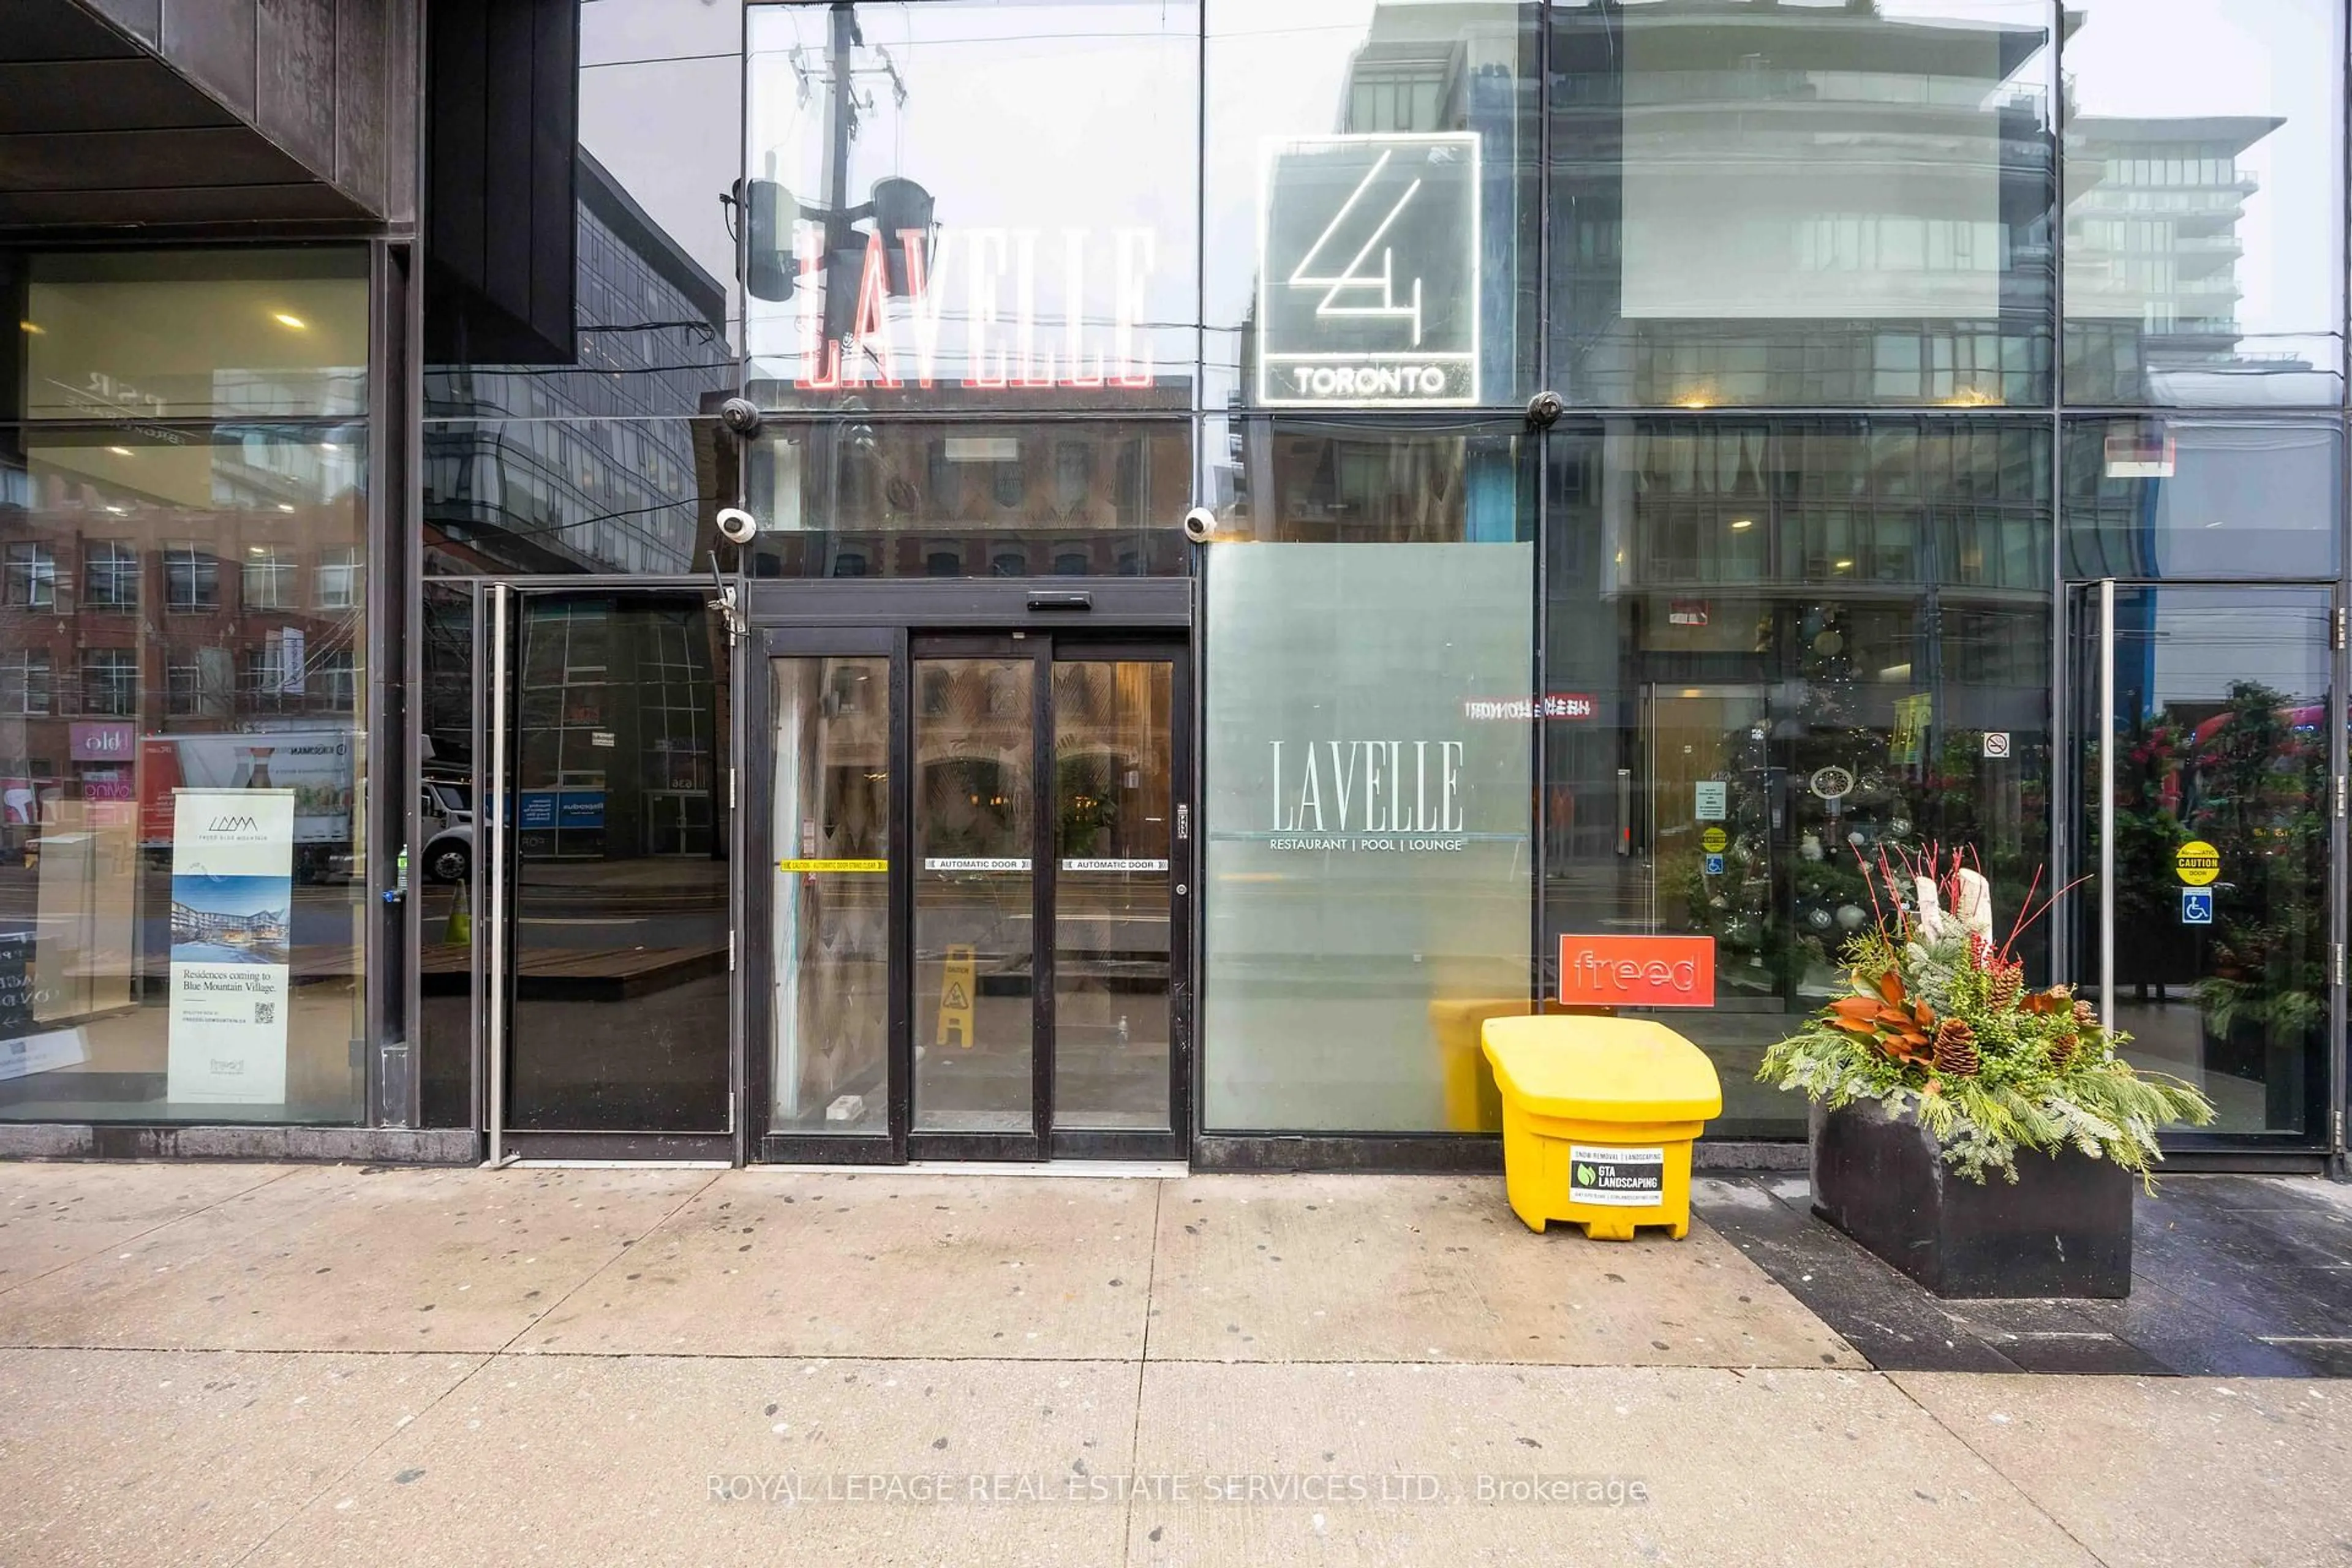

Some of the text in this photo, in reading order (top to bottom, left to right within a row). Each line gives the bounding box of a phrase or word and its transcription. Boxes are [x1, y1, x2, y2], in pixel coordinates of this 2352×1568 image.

[794, 228, 1156, 389] LAVELLE
[1293, 367, 1445, 393] TORONTO
[1269, 741, 1463, 832] LAVELLE
[1270, 839, 1462, 851] RESTAURANT POOL LOUNGE
[2178, 858, 2218, 867] CAUTION
[183, 968, 271, 981] Residences coming to
[1574, 950, 1701, 991] freed
[183, 981, 201, 990] Blue
[203, 982, 243, 991] Mountain
[1598, 1166, 1616, 1177] GTA
[1598, 1177, 1657, 1188] LANDSCAPING
